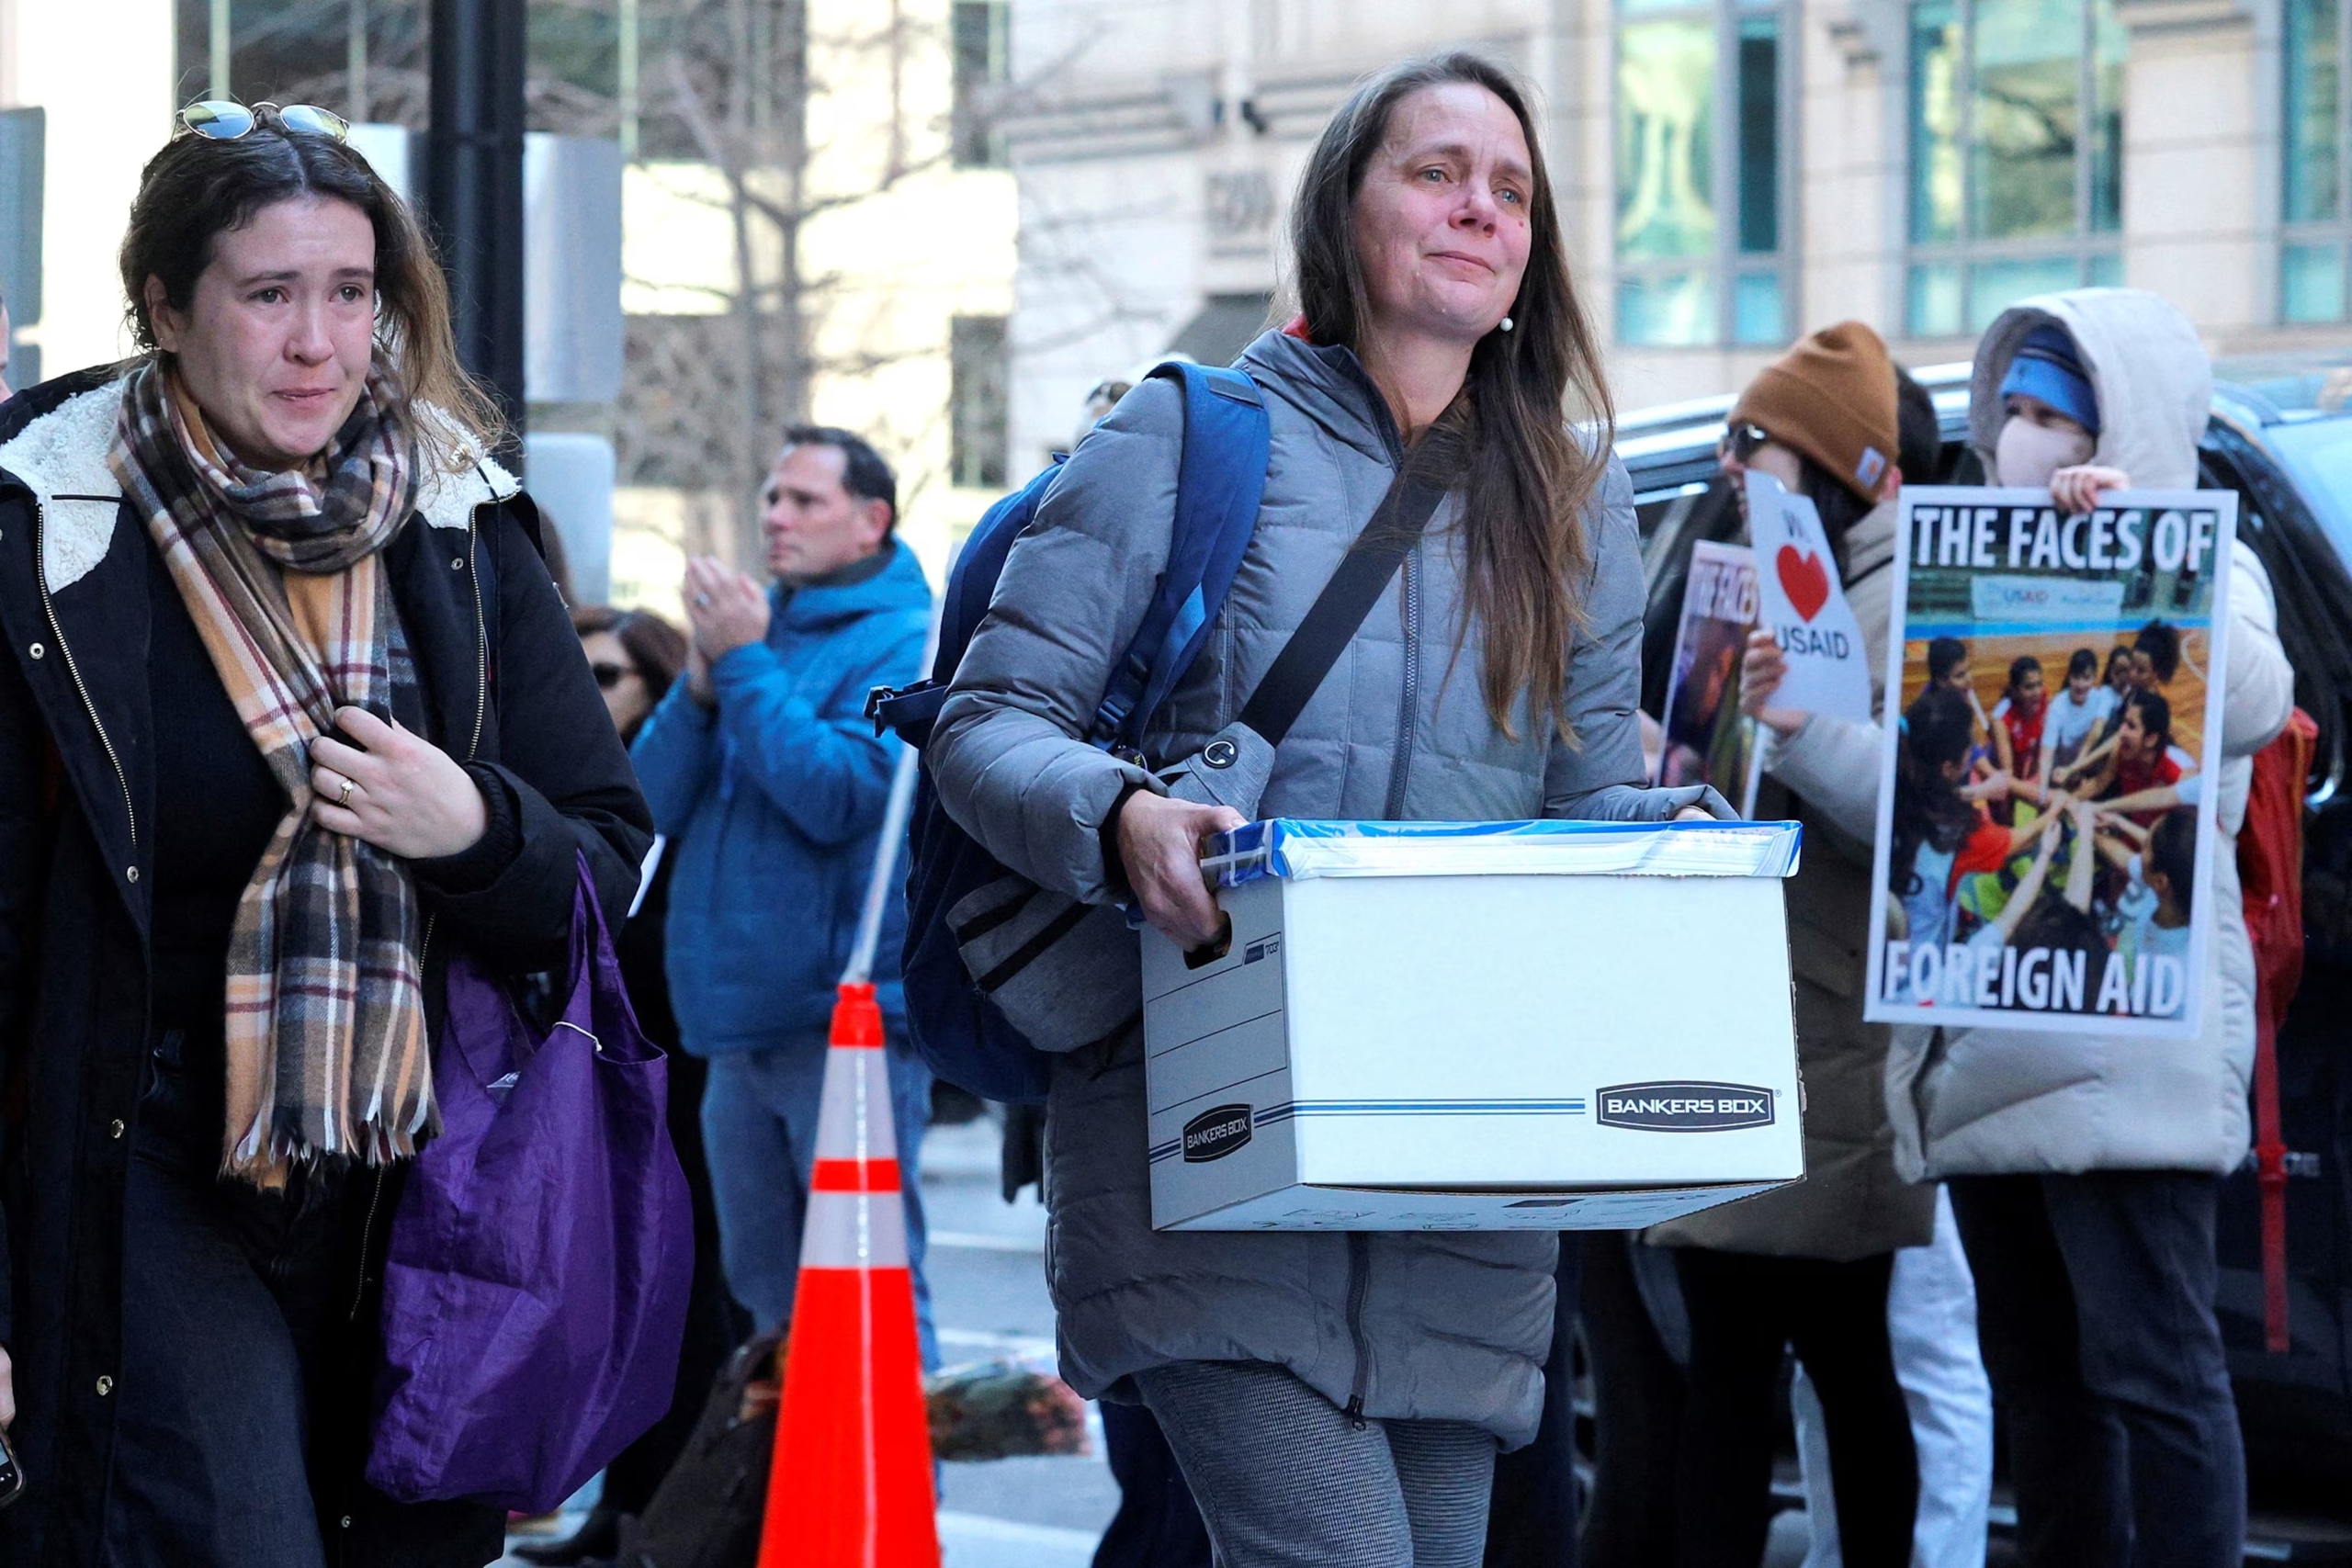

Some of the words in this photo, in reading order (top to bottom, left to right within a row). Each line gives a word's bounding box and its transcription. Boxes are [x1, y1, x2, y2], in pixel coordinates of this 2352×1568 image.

[1914, 507, 1997, 568] THE
[2007, 509, 2143, 570] FACES
[2152, 511, 2216, 572] OF
[1774, 625, 1849, 660] USAID
[1884, 941, 2086, 1010] FOREIGN
[2096, 952, 2185, 1017] AID
[1608, 1099, 1714, 1115] BANKERS
[1718, 1099, 1766, 1114] BOX
[1187, 1123, 1227, 1149] BANKERS
[1227, 1117, 1248, 1135] BOX
